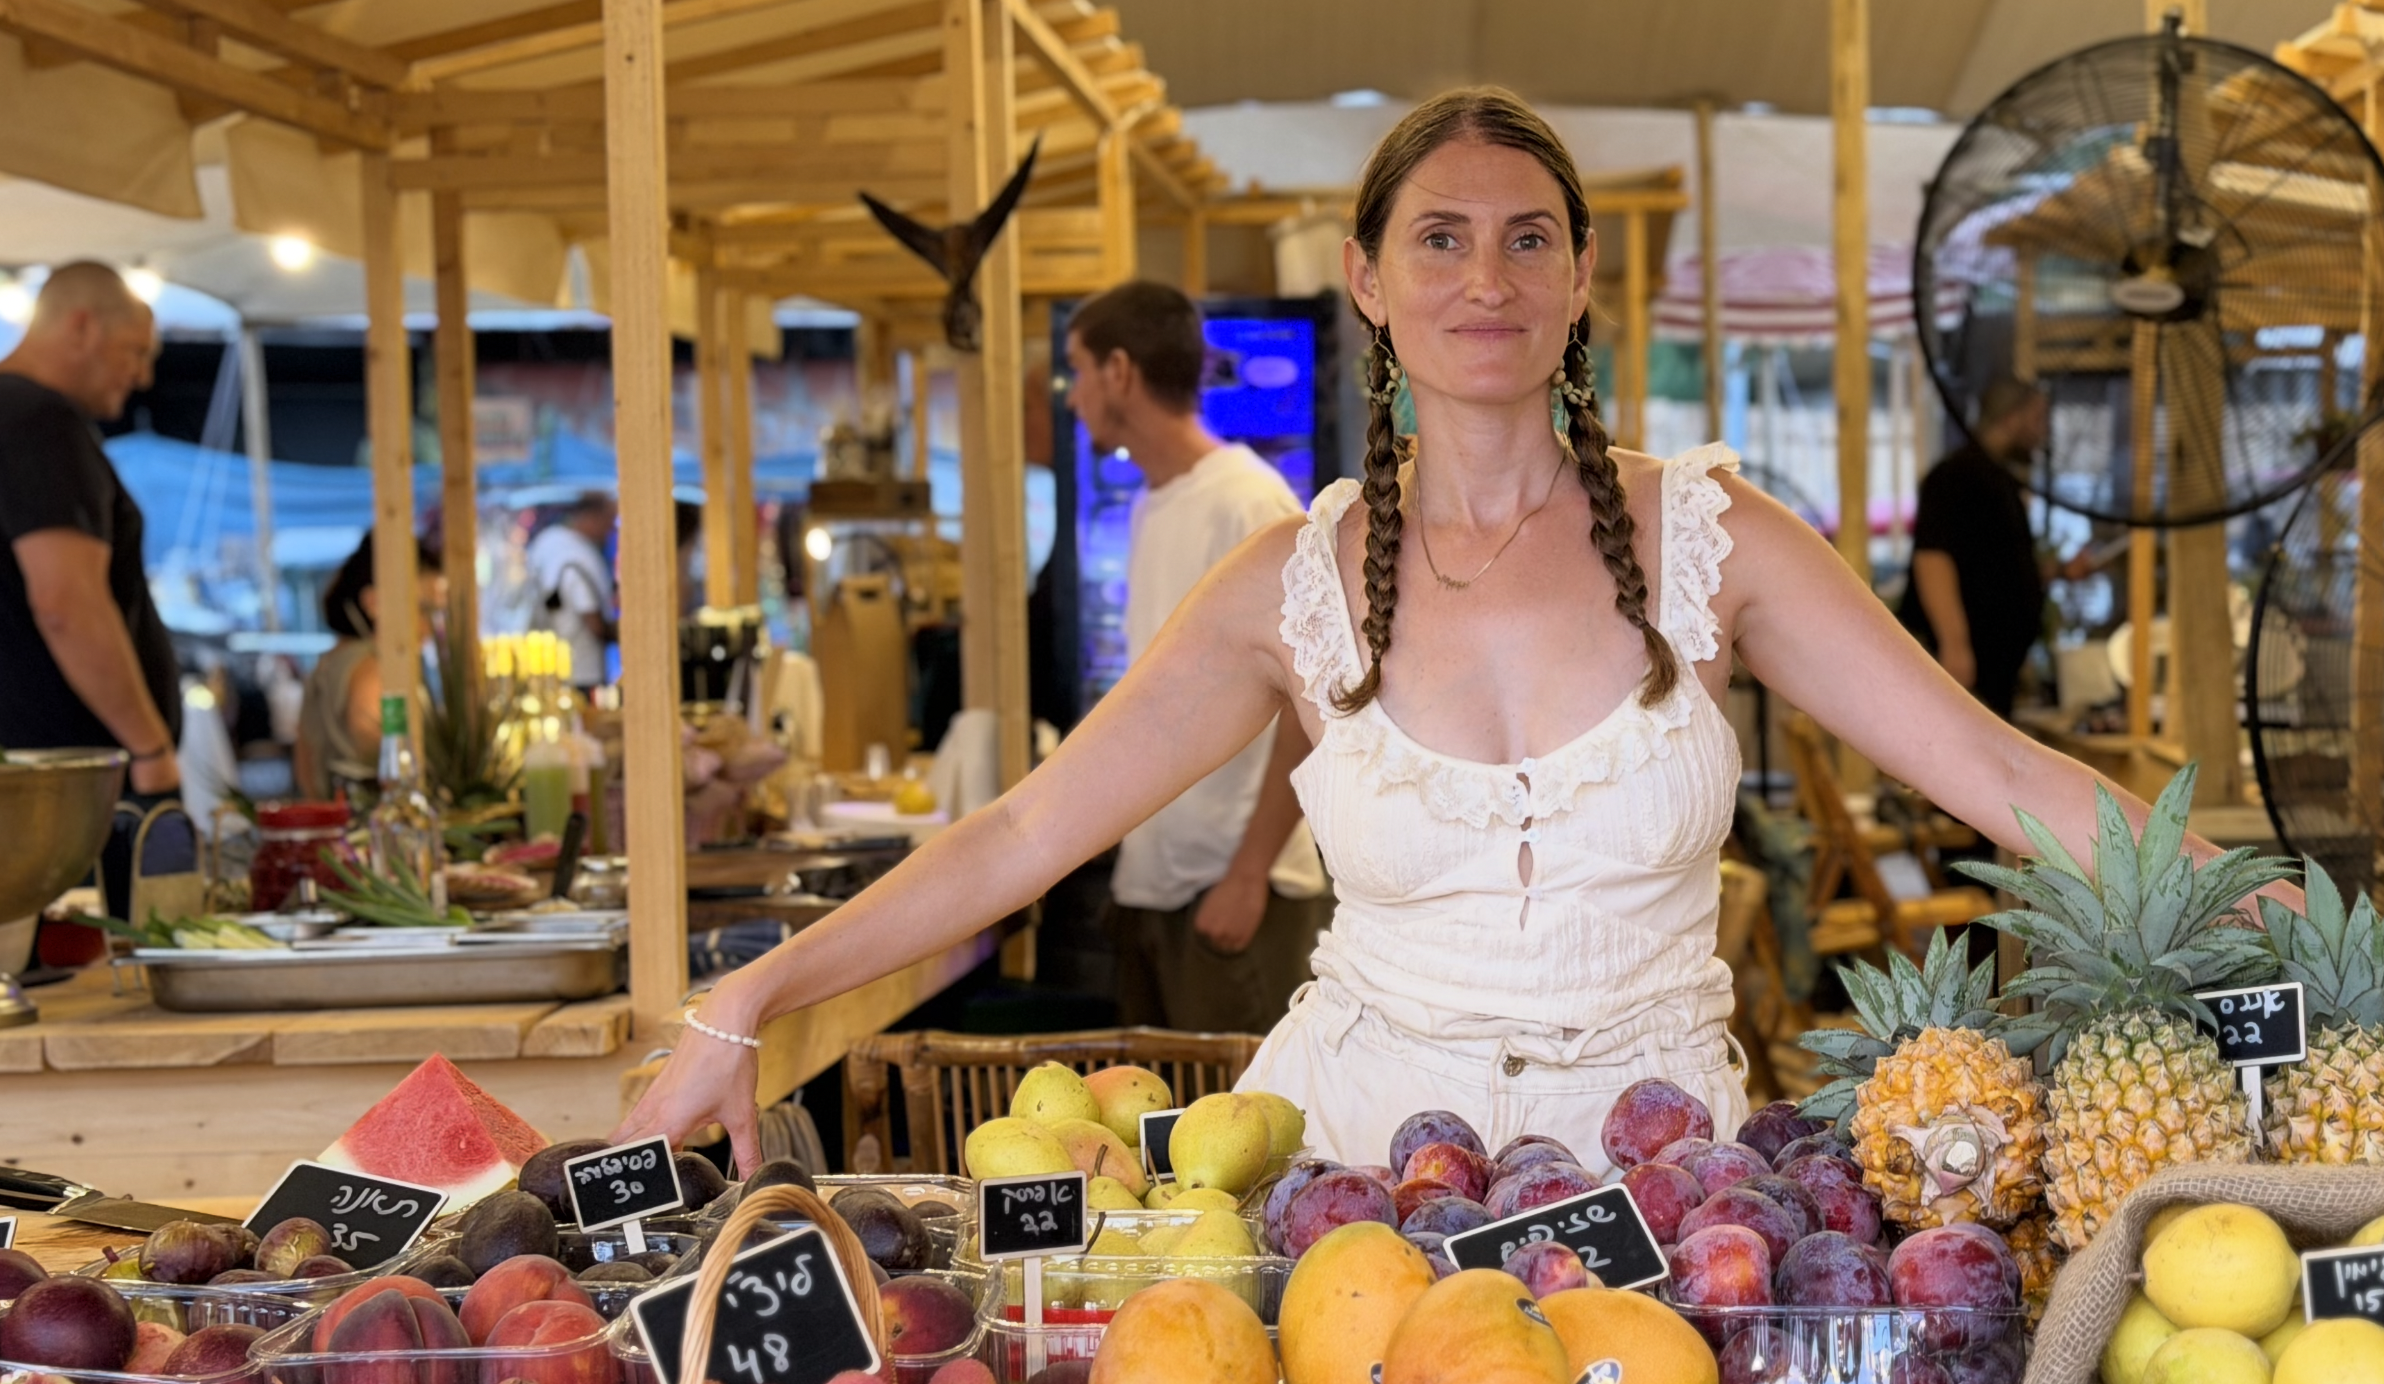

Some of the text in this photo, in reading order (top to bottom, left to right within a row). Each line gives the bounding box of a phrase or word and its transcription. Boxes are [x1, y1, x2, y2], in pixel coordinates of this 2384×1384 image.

[2219, 989, 2286, 1019] אננס
[2223, 1022, 2263, 1045] 22
[330, 1186, 419, 1217] תאנה
[610, 1180, 645, 1204] 30
[1001, 1182, 1073, 1215] אפרסק
[331, 1223, 381, 1250] 35
[1020, 1210, 1058, 1236] 22
[2335, 1256, 2384, 1298] ימון
[2355, 1289, 2384, 1312] 15
[727, 1333, 790, 1384] 48
